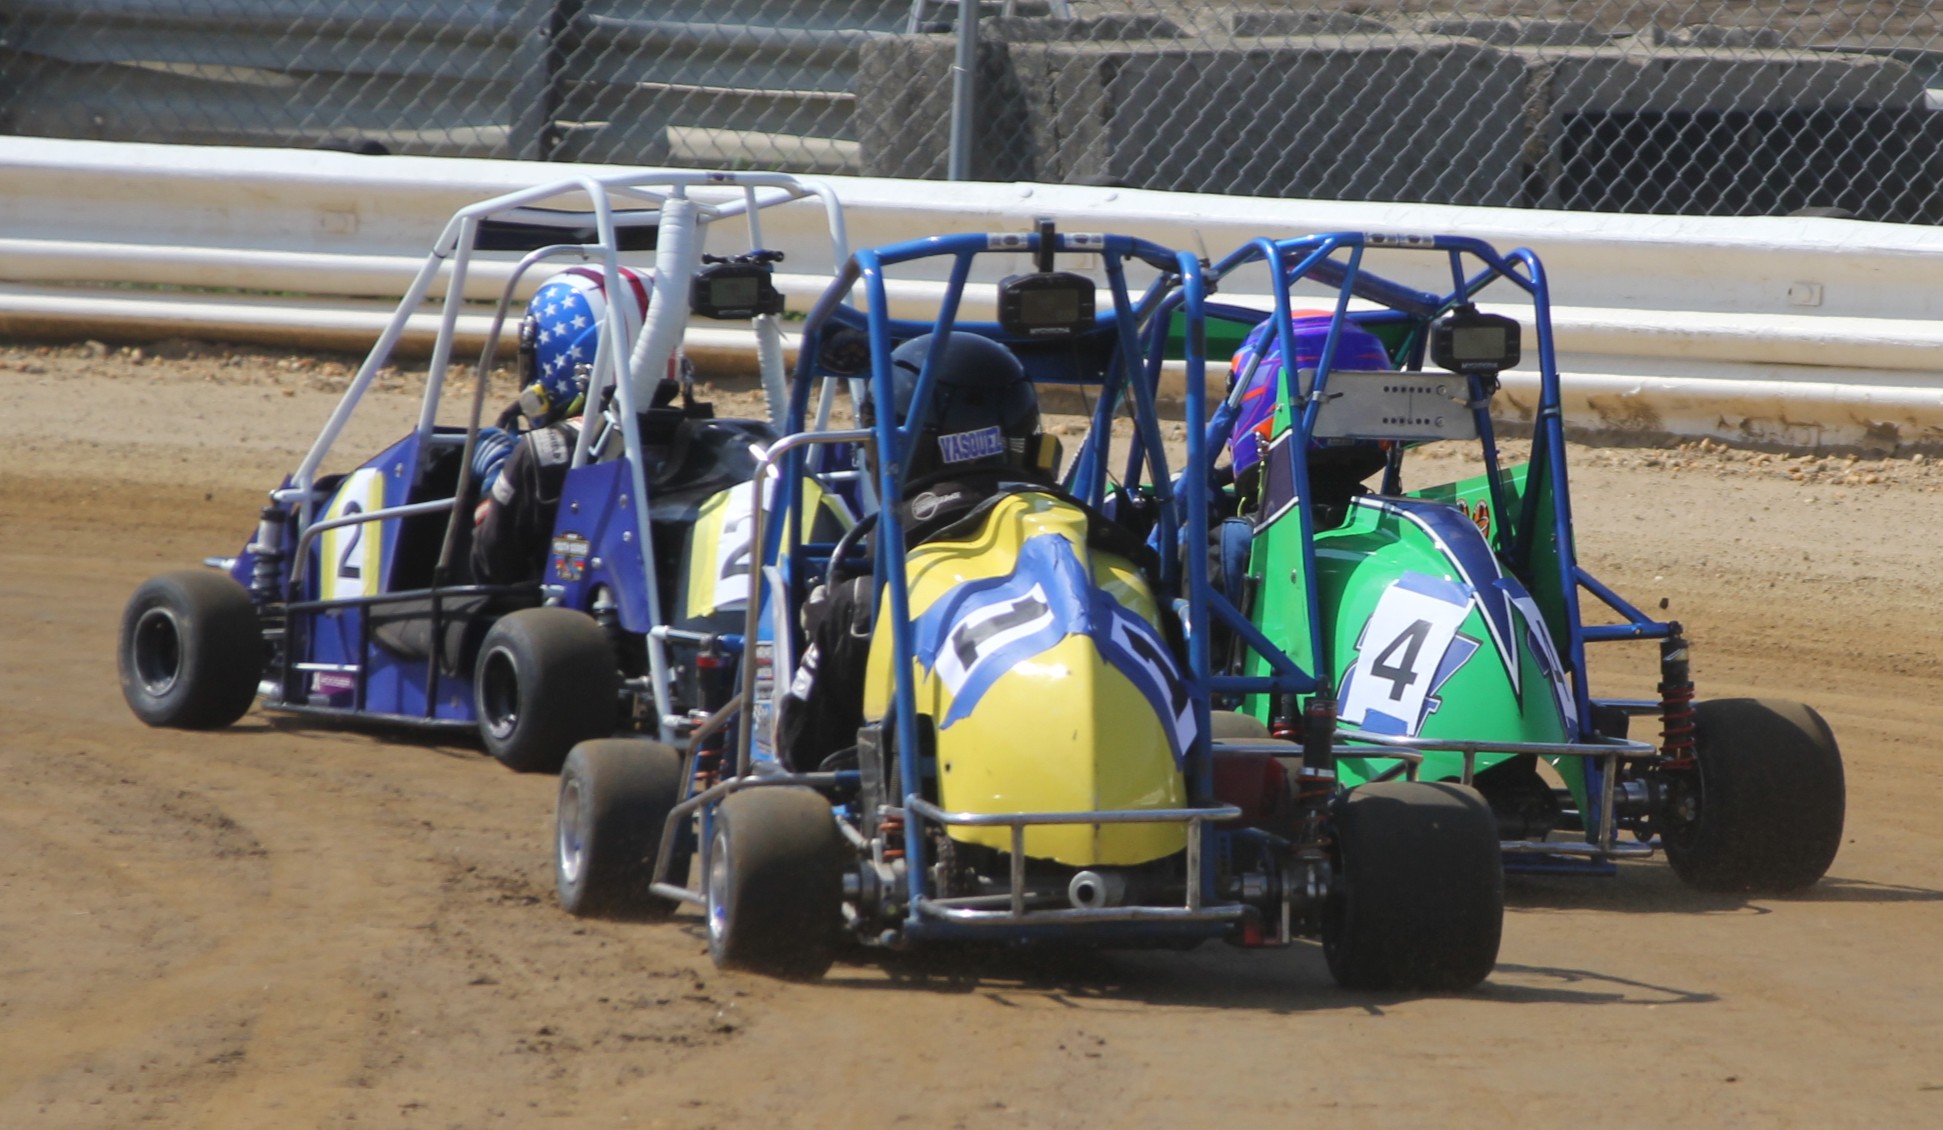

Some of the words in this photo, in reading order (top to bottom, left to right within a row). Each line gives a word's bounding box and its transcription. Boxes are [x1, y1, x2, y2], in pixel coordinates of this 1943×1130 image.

[939, 427, 1003, 463] VASQUEZ
[338, 500, 363, 579] 2
[720, 511, 769, 580] 2
[951, 595, 1048, 672] 1
[1370, 618, 1433, 701] 4
